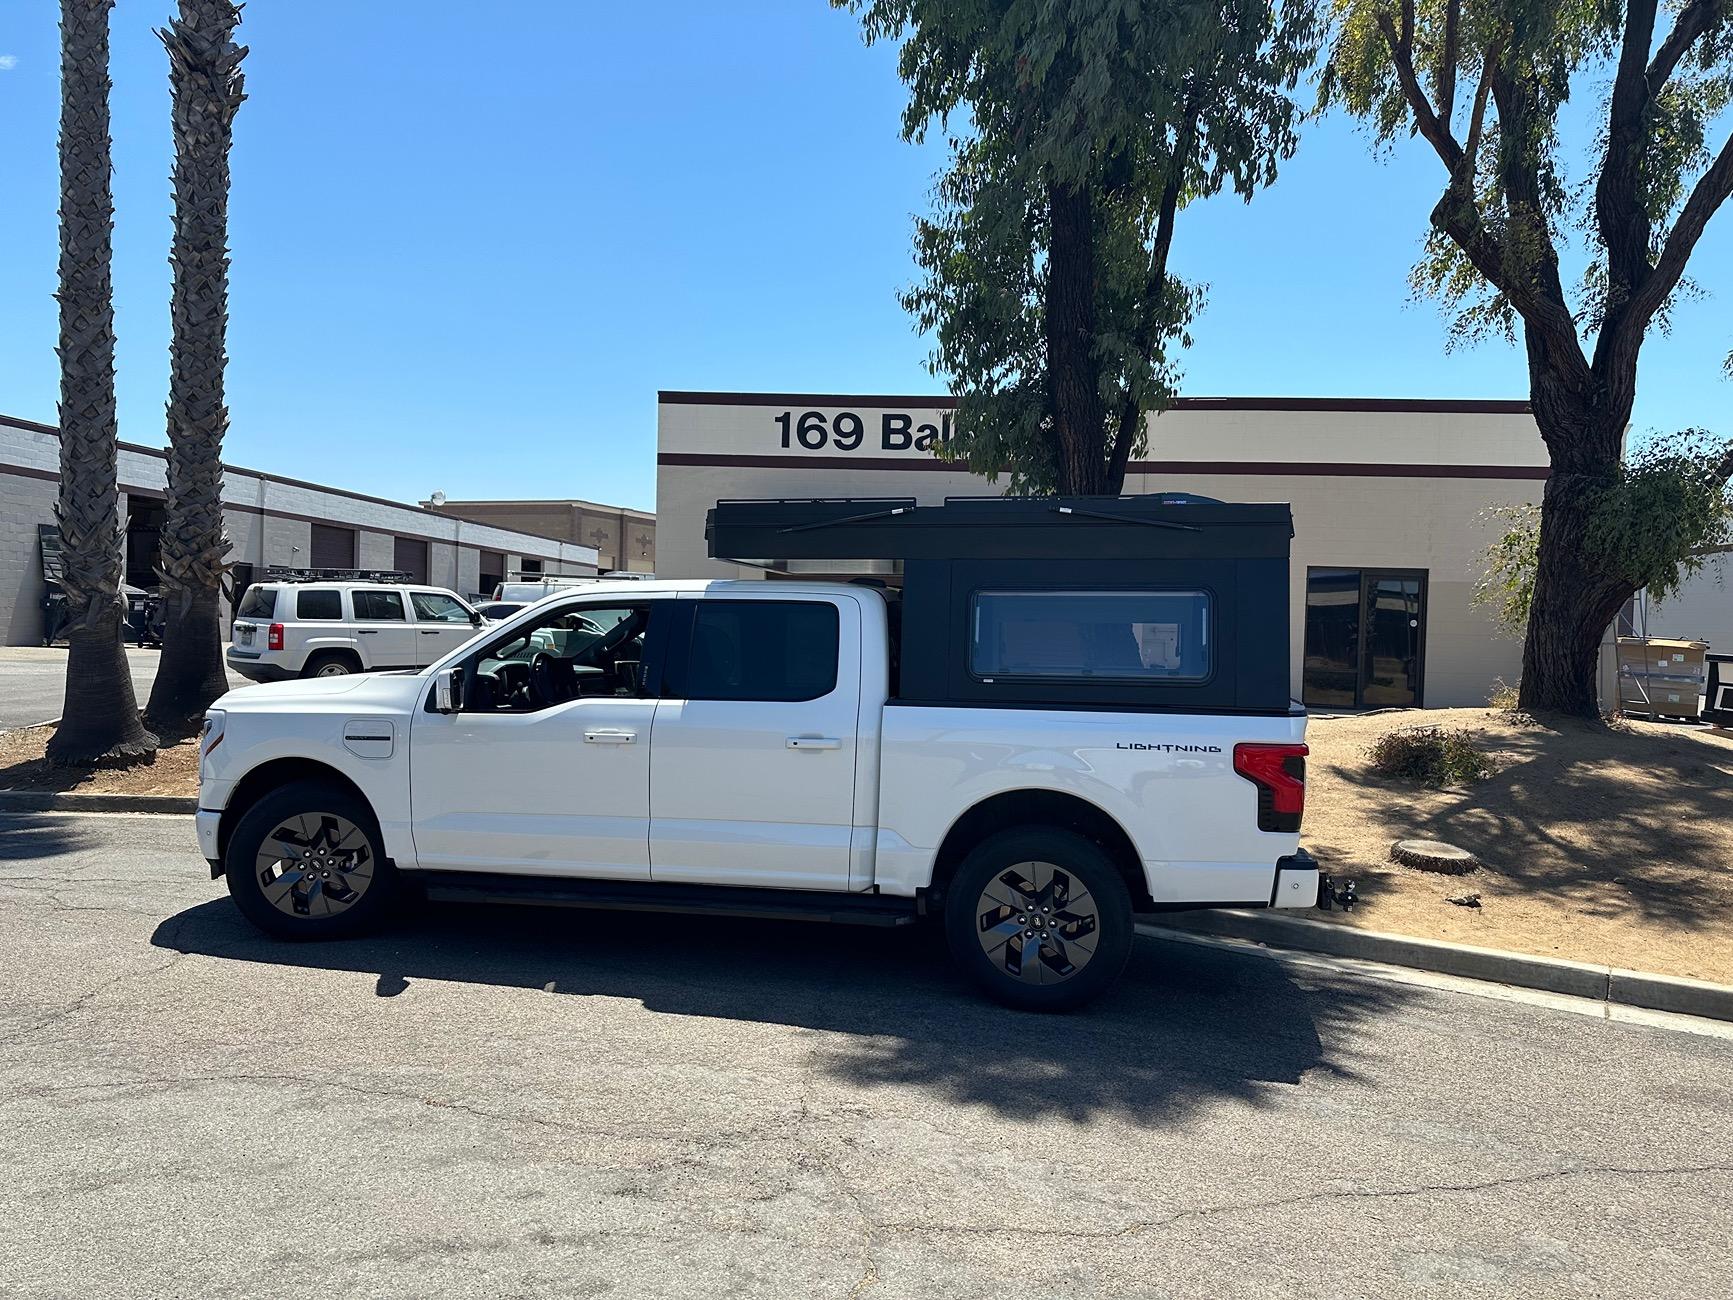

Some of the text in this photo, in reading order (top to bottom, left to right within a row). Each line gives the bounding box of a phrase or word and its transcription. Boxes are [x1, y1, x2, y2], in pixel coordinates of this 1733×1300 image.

[775, 411, 956, 452] 169 Bal
[1116, 742, 1222, 753] LIGHTNING
